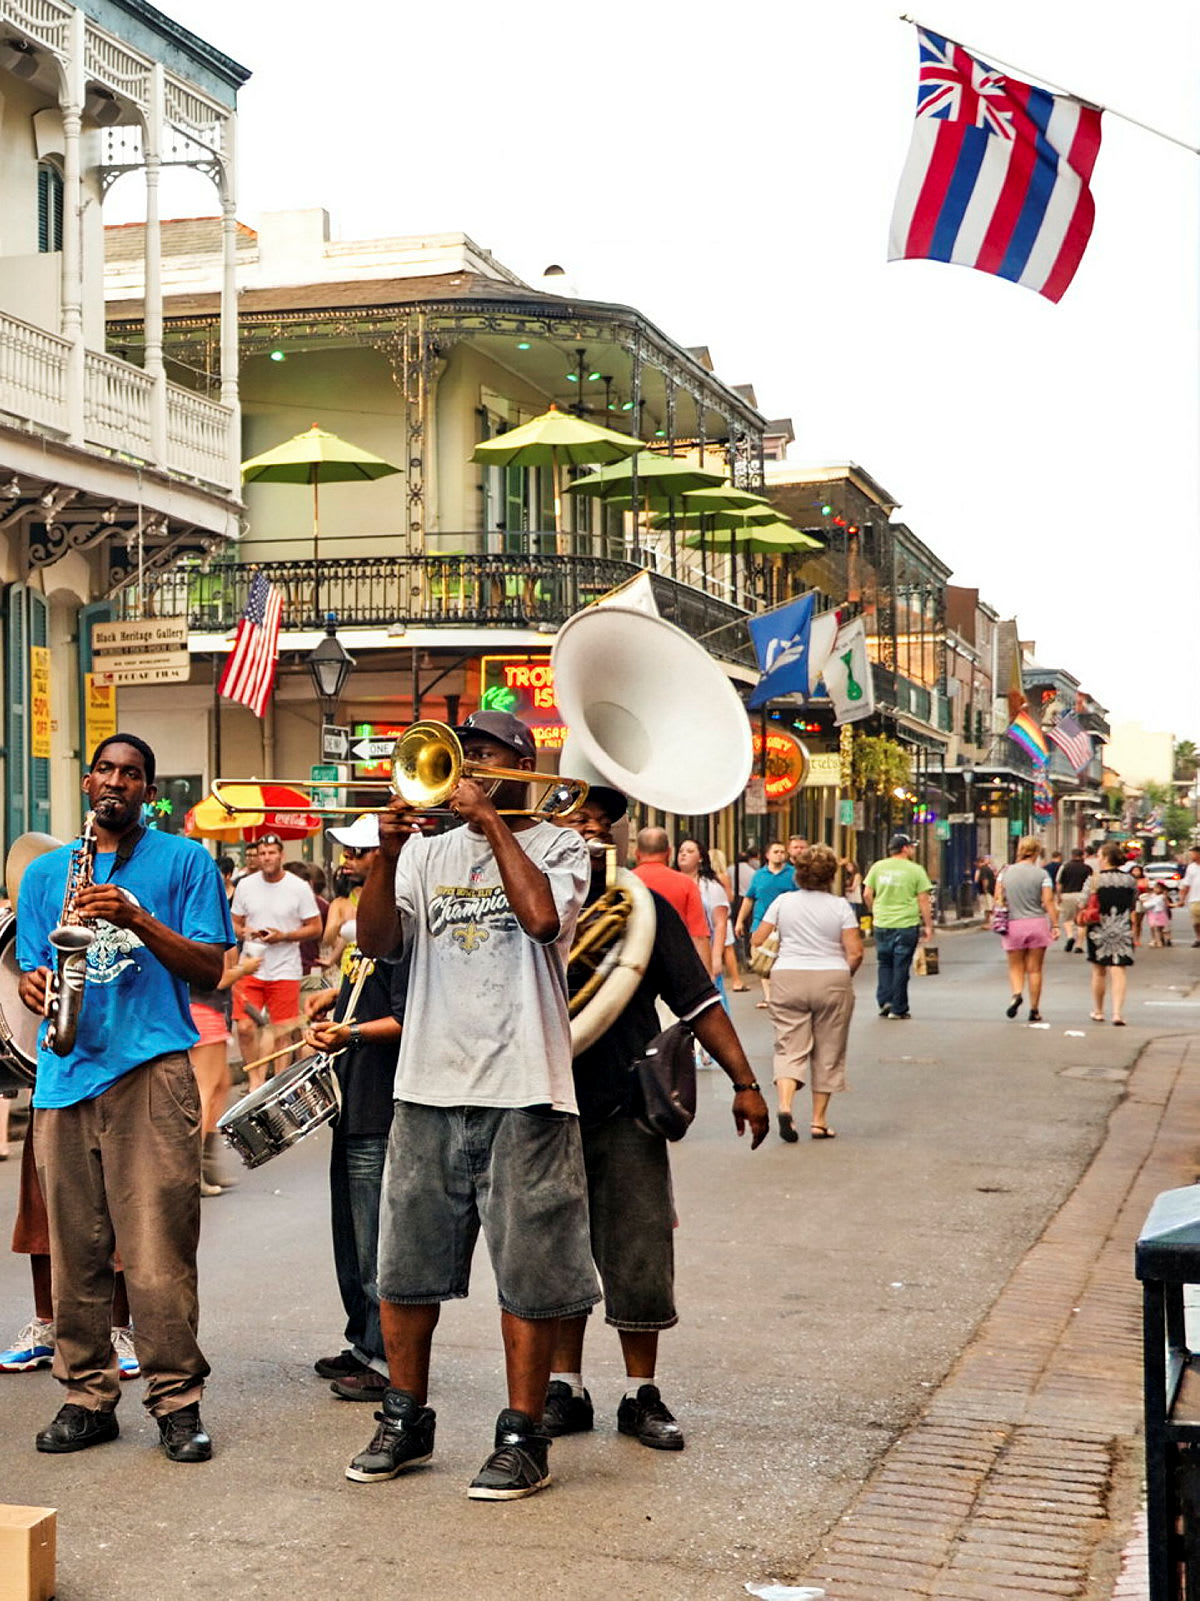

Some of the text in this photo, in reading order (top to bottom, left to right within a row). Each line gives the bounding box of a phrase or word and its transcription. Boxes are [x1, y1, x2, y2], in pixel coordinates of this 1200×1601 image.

[96, 628, 184, 643] Black Heritage Gallery
[369, 743, 390, 754] ONE
